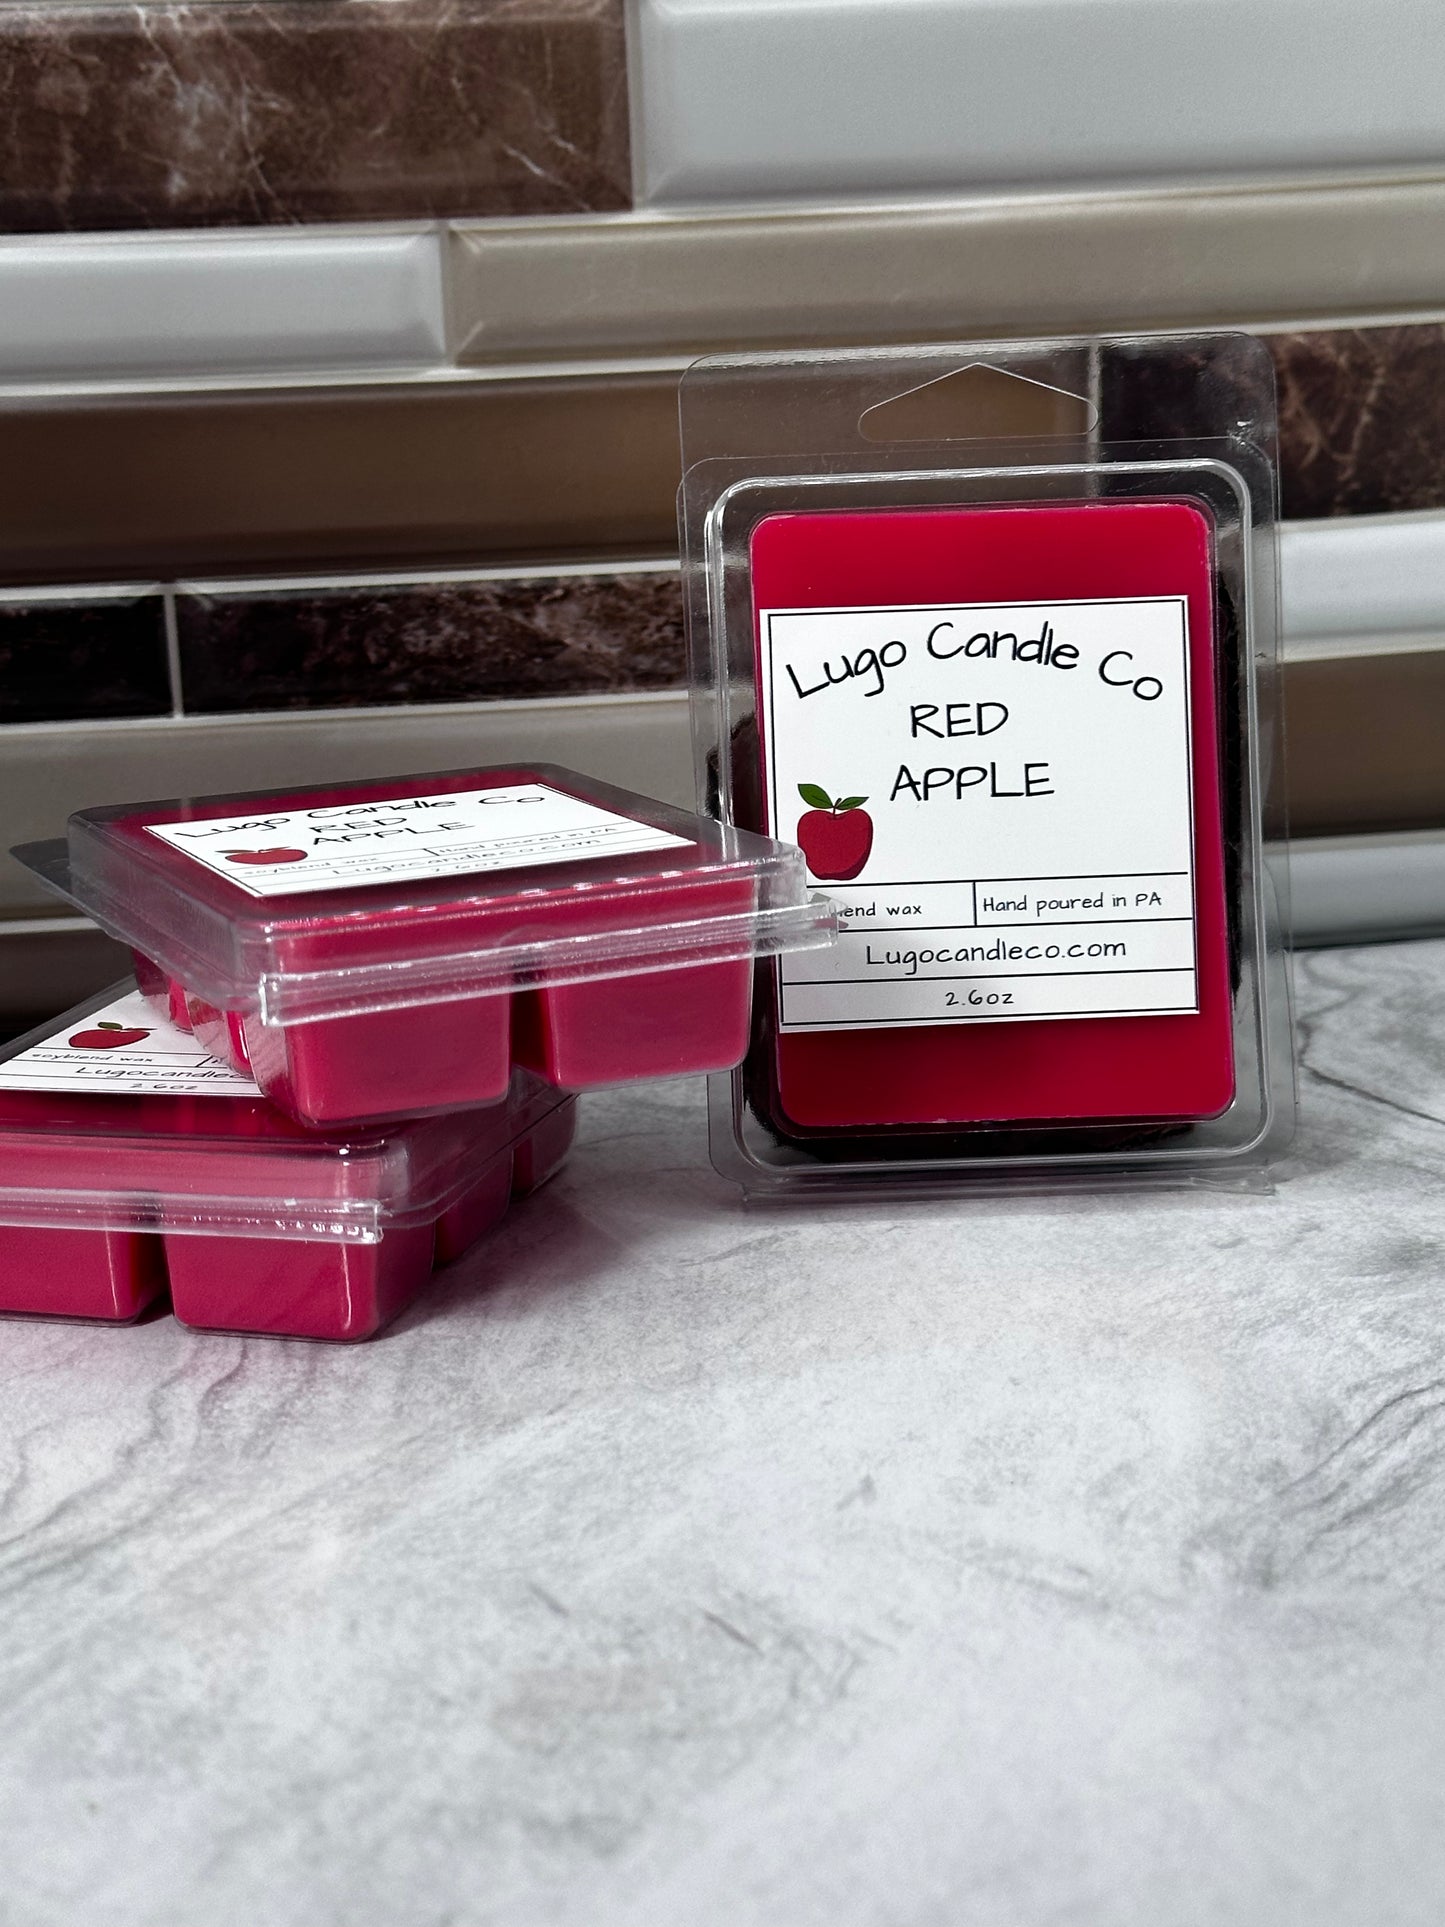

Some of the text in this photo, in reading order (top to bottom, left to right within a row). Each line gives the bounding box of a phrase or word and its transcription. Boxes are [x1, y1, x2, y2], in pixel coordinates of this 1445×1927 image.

[786, 621, 1163, 701] Lugo Candle Co
[910, 702, 1009, 738] RED
[889, 762, 1055, 801] APPLE
[174, 796, 546, 838] Lugo Candle Co
[308, 817, 407, 833] RED
[313, 822, 475, 845] APPLE
[886, 904, 923, 917] wax
[983, 892, 1163, 917] Hand poured in PA
[866, 939, 1127, 976] Lugocandleco.com
[945, 990, 1015, 1007] 2.6oz
[32, 1053, 113, 1062] soyblend
